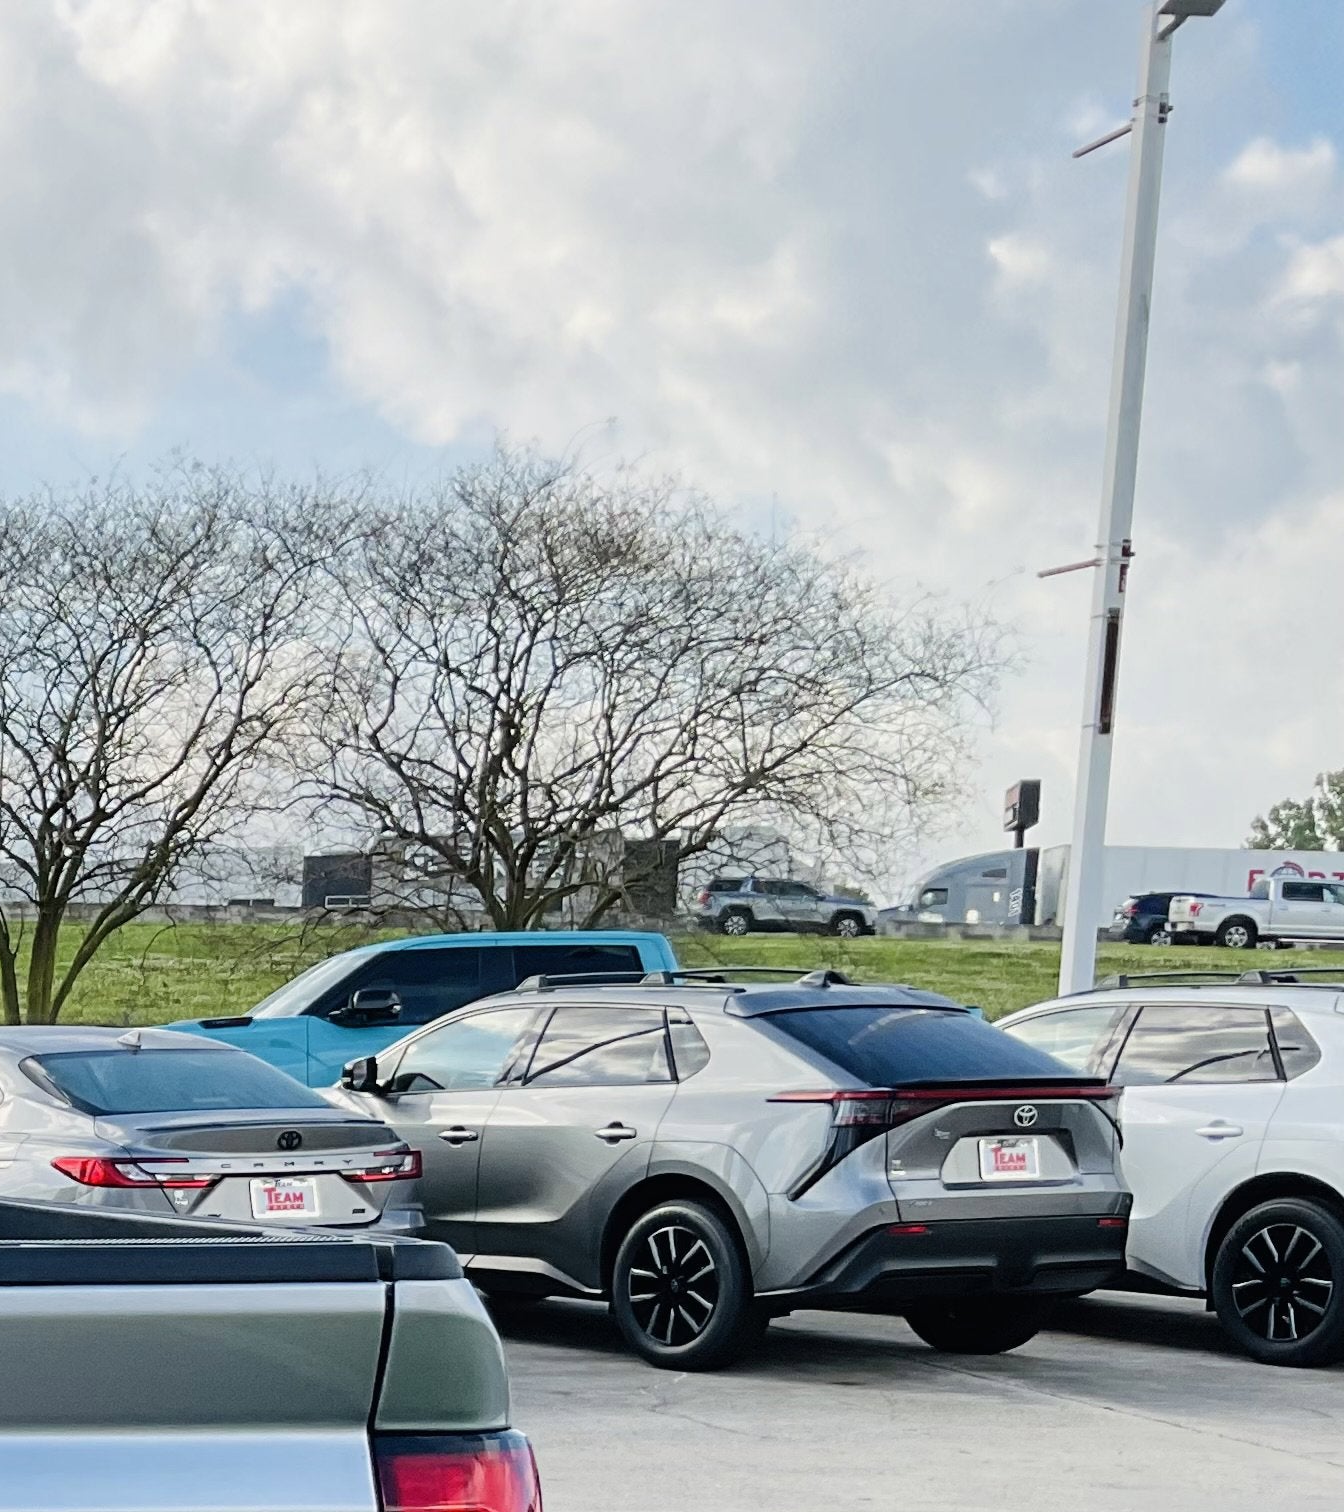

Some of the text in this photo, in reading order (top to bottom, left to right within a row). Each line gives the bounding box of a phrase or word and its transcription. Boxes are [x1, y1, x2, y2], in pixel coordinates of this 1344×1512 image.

[221, 1159, 352, 1168] CAMRY
[992, 1146, 1025, 1165] TEAM
[263, 1187, 304, 1205] TEAM
